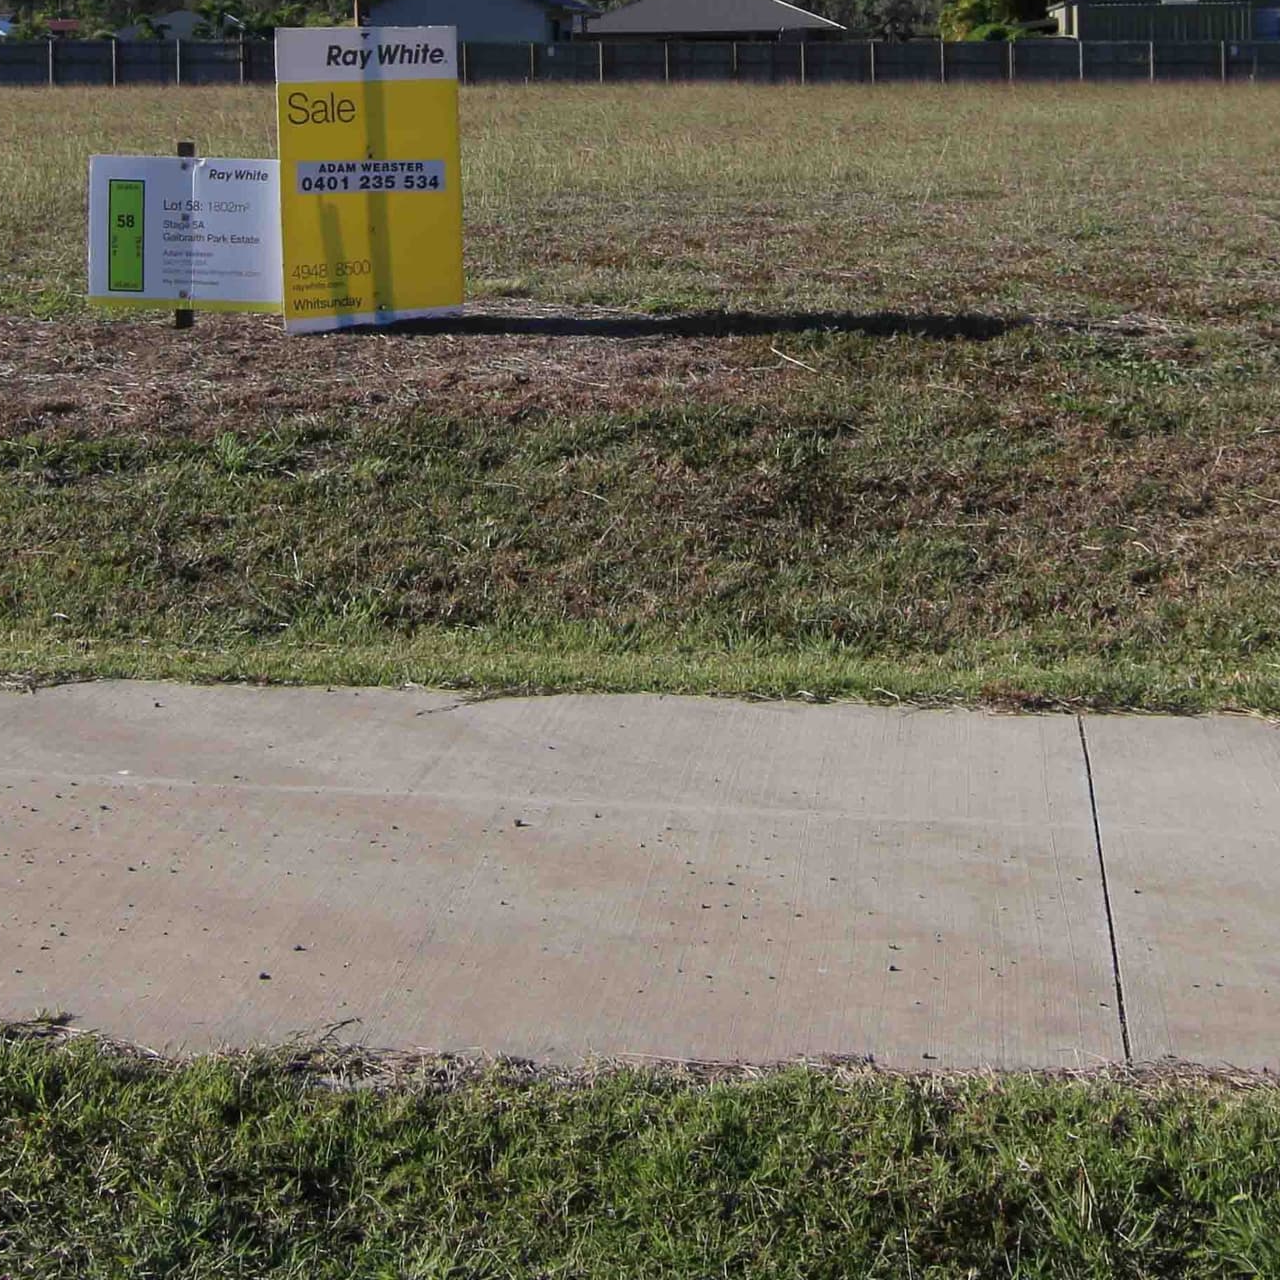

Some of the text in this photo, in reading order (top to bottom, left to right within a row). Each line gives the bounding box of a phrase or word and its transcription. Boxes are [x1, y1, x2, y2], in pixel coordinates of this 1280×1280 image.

[326, 44, 445, 70] Ray White
[288, 92, 356, 125] Sale
[209, 169, 270, 183] Ray White
[319, 163, 424, 174] ADAM WEBSTER
[302, 176, 440, 191] 0401 235 534
[164, 200, 183, 212] Lot
[186, 201, 204, 212] 58:
[117, 214, 135, 229] 58
[163, 220, 205, 232] Stage 5A
[163, 234, 260, 245] Galbraith Park Estate
[292, 260, 372, 280] 4948 8500
[293, 297, 363, 312] Whitsunday
